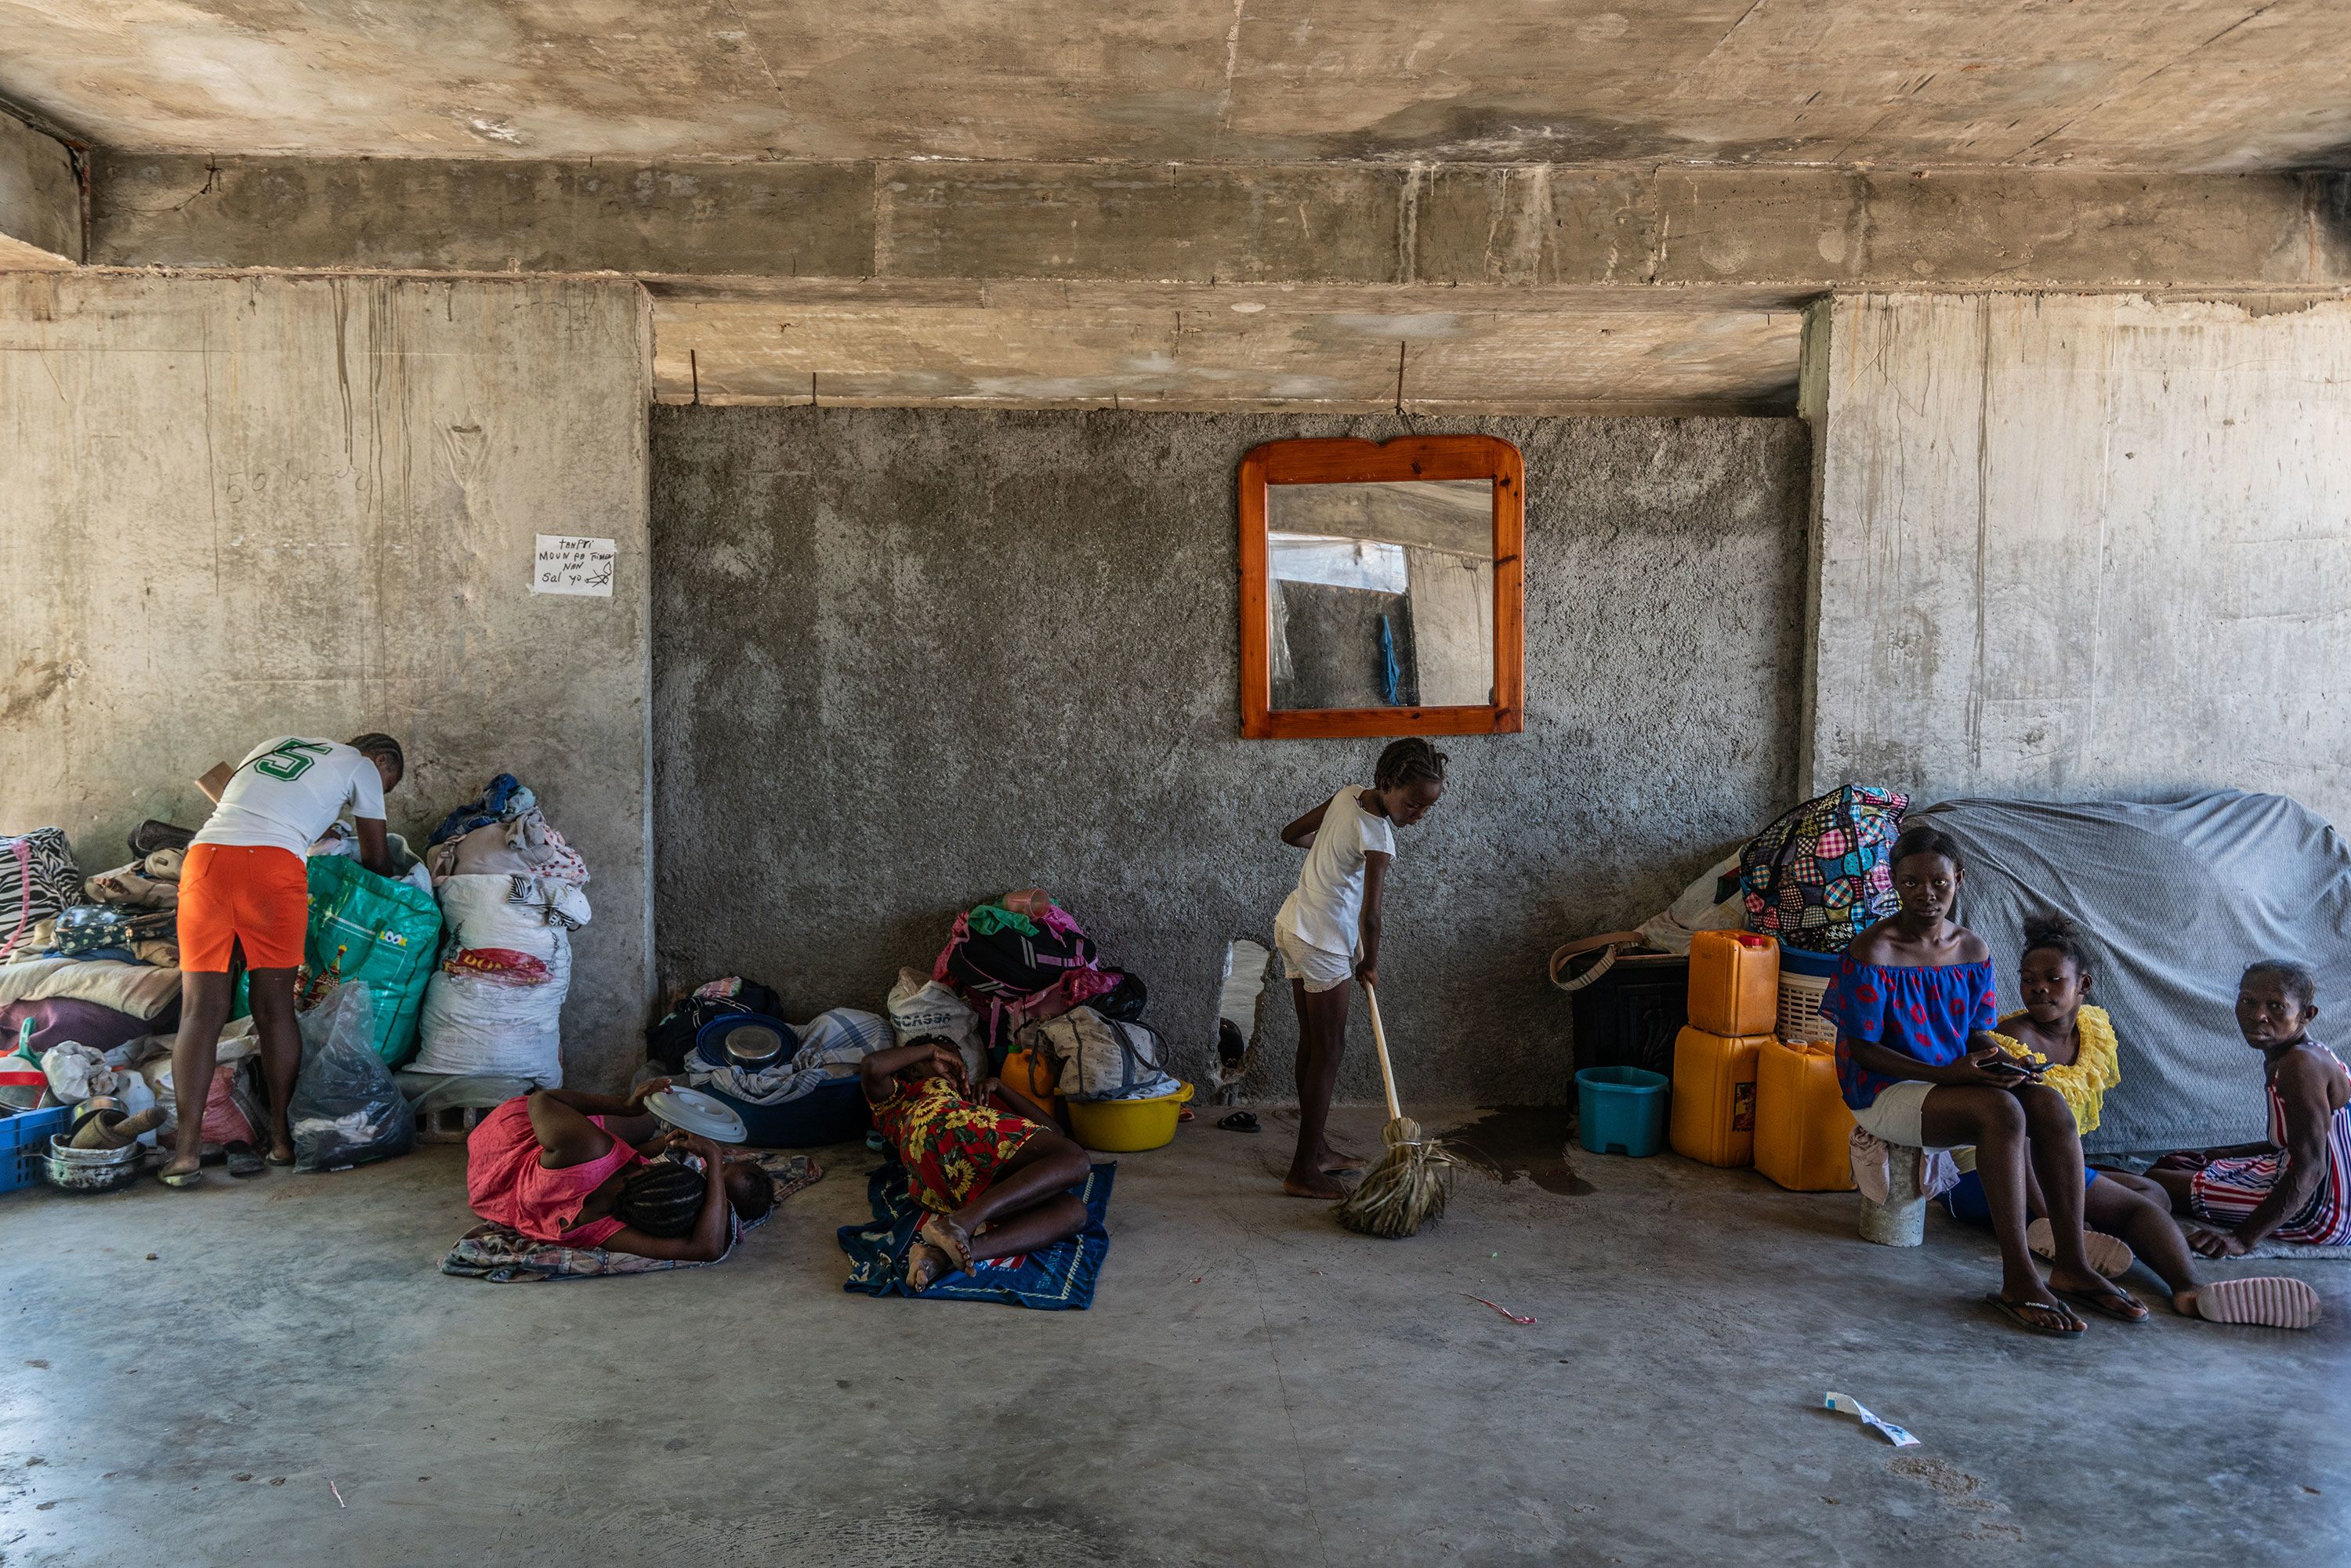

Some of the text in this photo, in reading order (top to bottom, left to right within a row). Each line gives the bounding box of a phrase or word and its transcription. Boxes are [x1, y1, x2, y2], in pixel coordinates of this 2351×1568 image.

[539, 551, 570, 561] MOUN
[542, 571, 562, 583] Sal
[253, 737, 333, 782] 5
